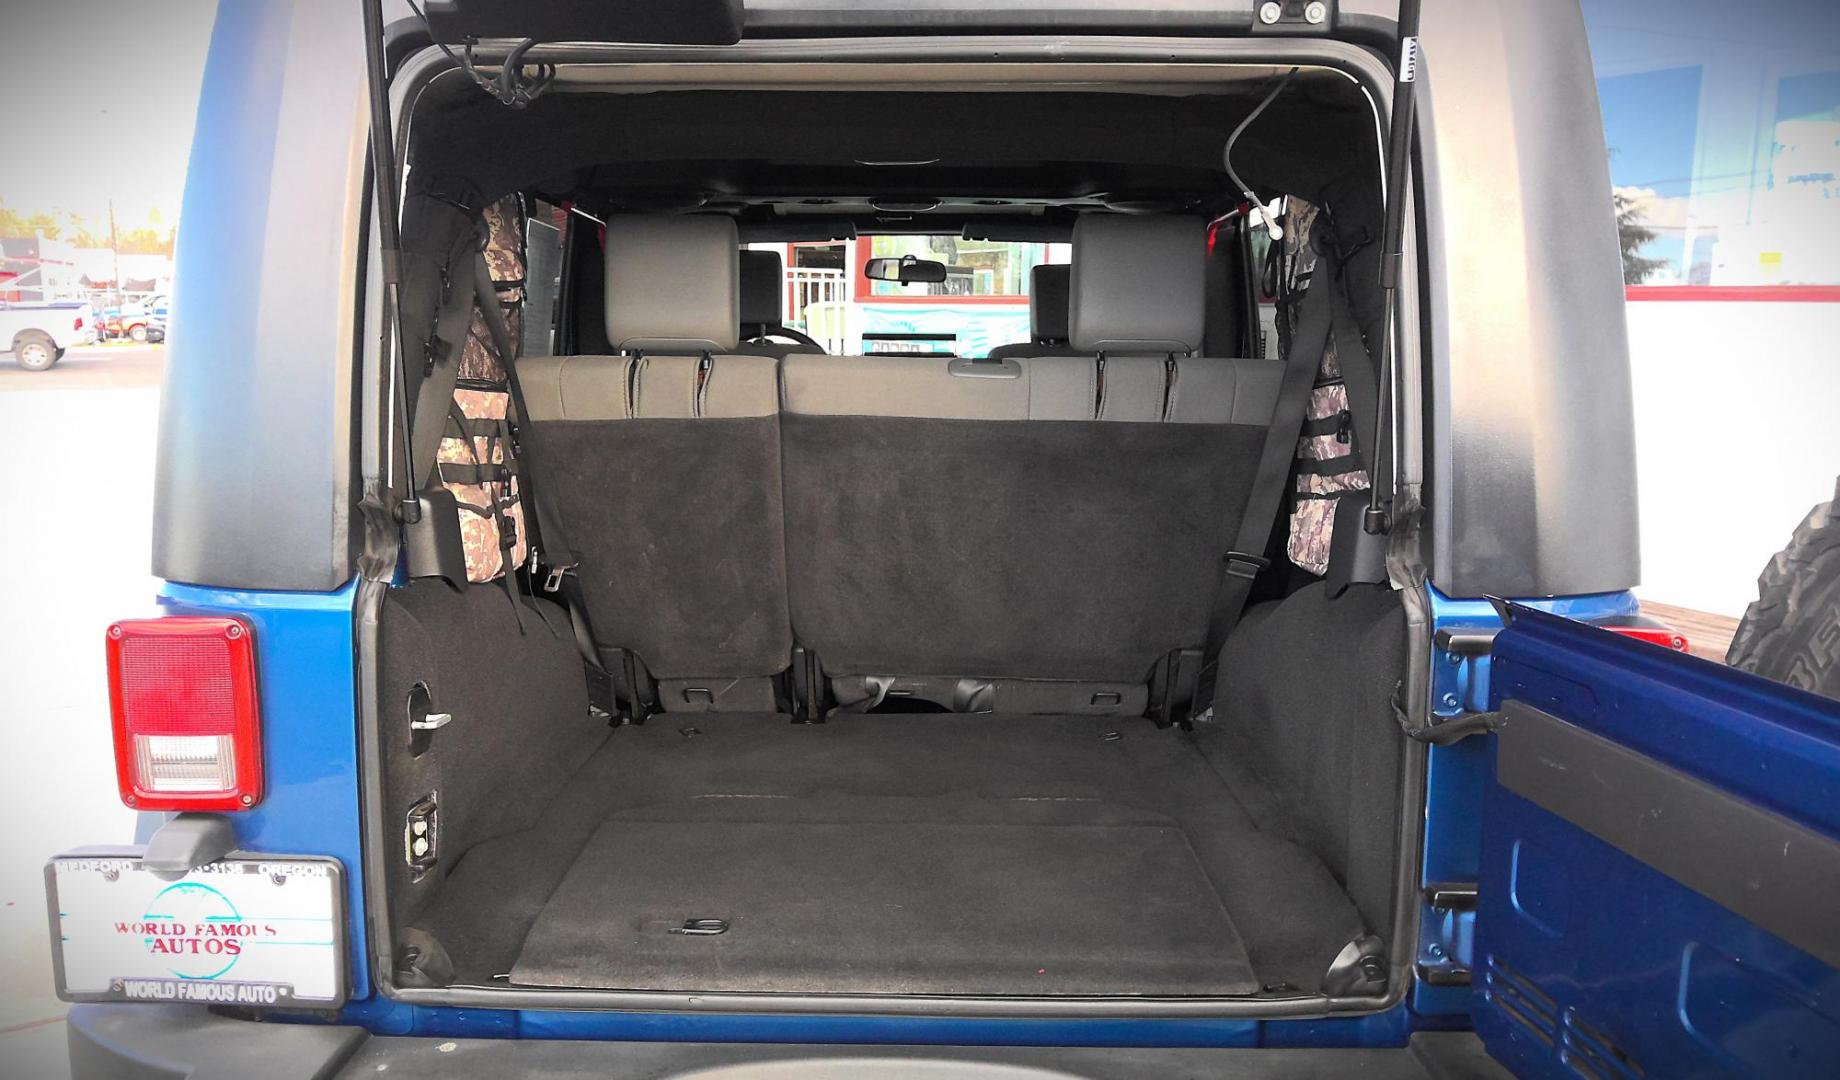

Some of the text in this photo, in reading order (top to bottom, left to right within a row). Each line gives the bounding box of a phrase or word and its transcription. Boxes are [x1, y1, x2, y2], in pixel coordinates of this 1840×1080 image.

[58, 860, 134, 872] MEDFORD
[258, 863, 327, 877] OREGON
[114, 922, 277, 937] WORLD FAMOUS
[150, 938, 241, 956] AUTOS
[125, 980, 277, 1003] WORLD FAMOUS AUTO
